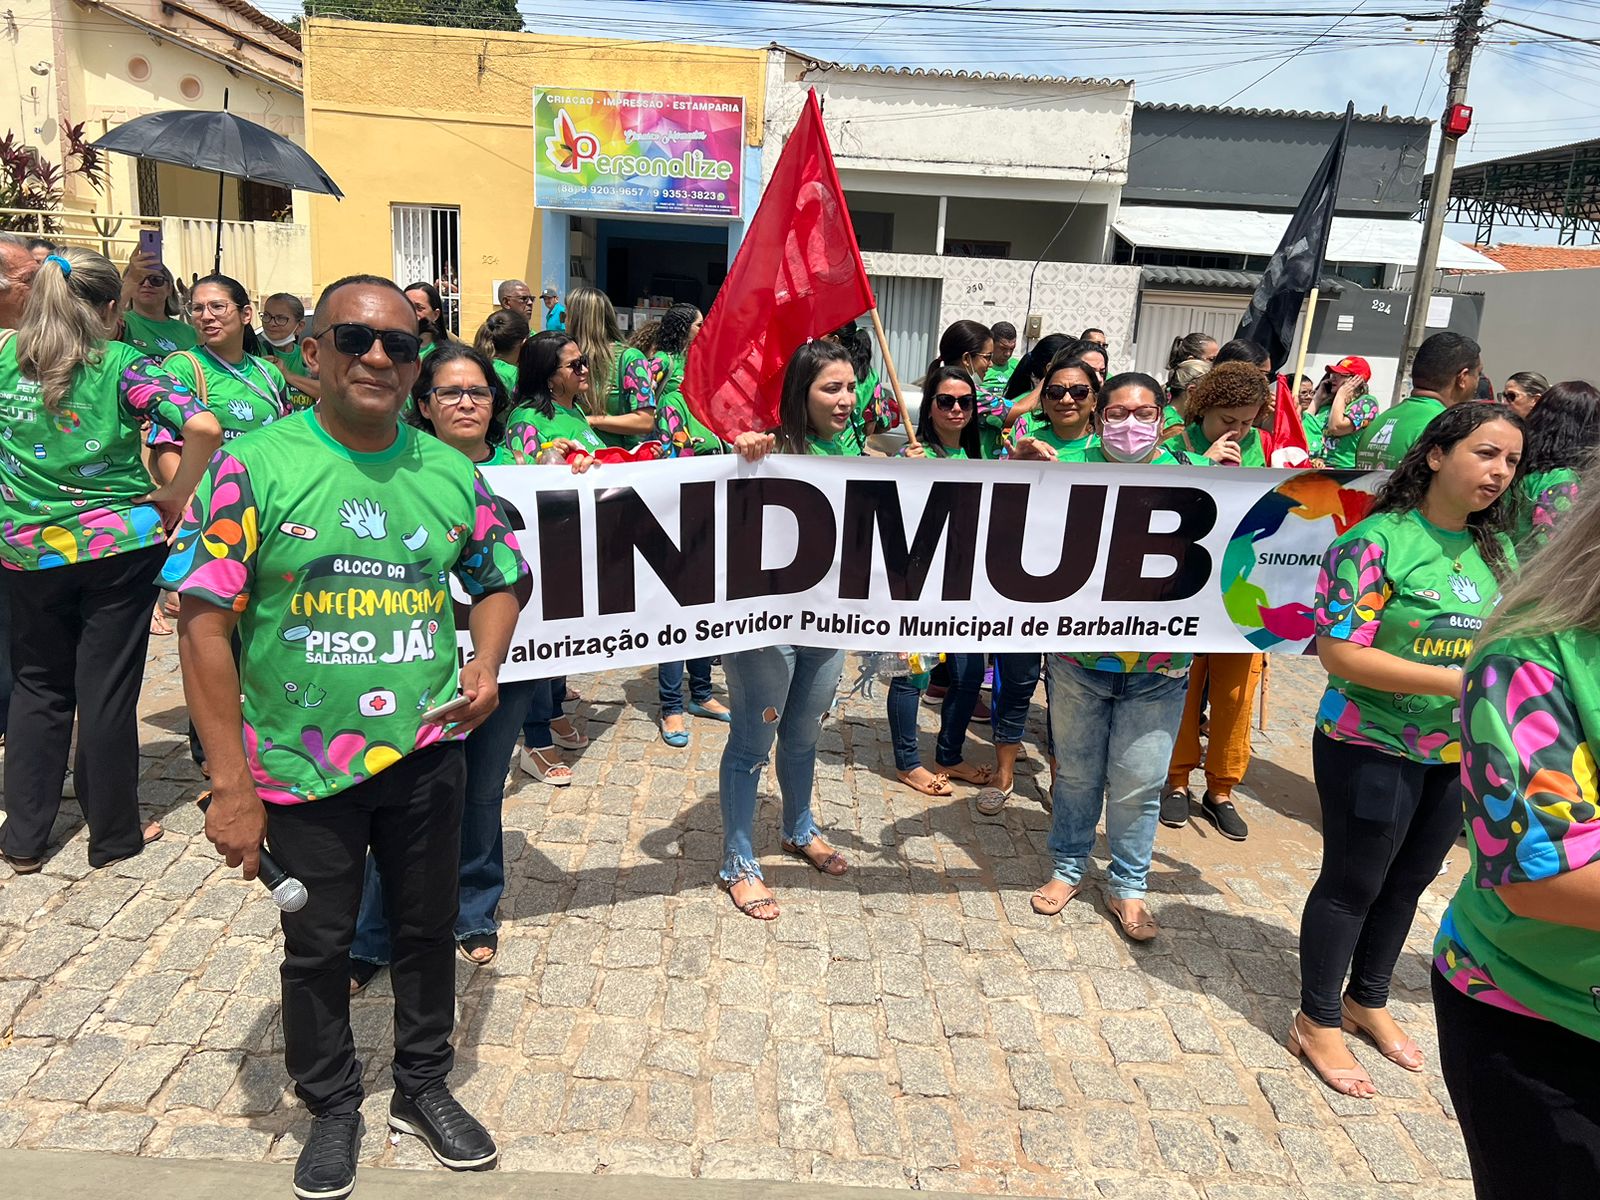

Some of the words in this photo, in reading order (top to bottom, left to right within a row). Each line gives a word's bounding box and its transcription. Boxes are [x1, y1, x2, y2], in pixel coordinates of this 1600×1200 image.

[673, 101, 740, 113] ESTAMPARIA
[570, 134, 732, 181] Personalize
[581, 184, 587, 194] 9
[590, 184, 644, 196] 9203-9657
[653, 188, 659, 198] 9
[662, 189, 716, 201] 9353-3823
[966, 282, 983, 294] 230
[1371, 299, 1391, 315] 224
[333, 558, 383, 575] BLOCO
[387, 562, 406, 579] DA
[290, 587, 446, 619] ENFERMAGEM
[1449, 615, 1482, 630] BLOCO
[305, 630, 376, 653] PISO
[379, 619, 436, 663] JÁ!
[500, 628, 649, 664] alorização
[657, 624, 687, 646] do
[695, 610, 794, 641] Servidor
[800, 610, 891, 637] Publico
[899, 615, 1013, 642] Municipal
[1020, 615, 1049, 638] de
[1056, 615, 1200, 638] Barbalha-CE
[305, 651, 378, 665] SALARIAL
